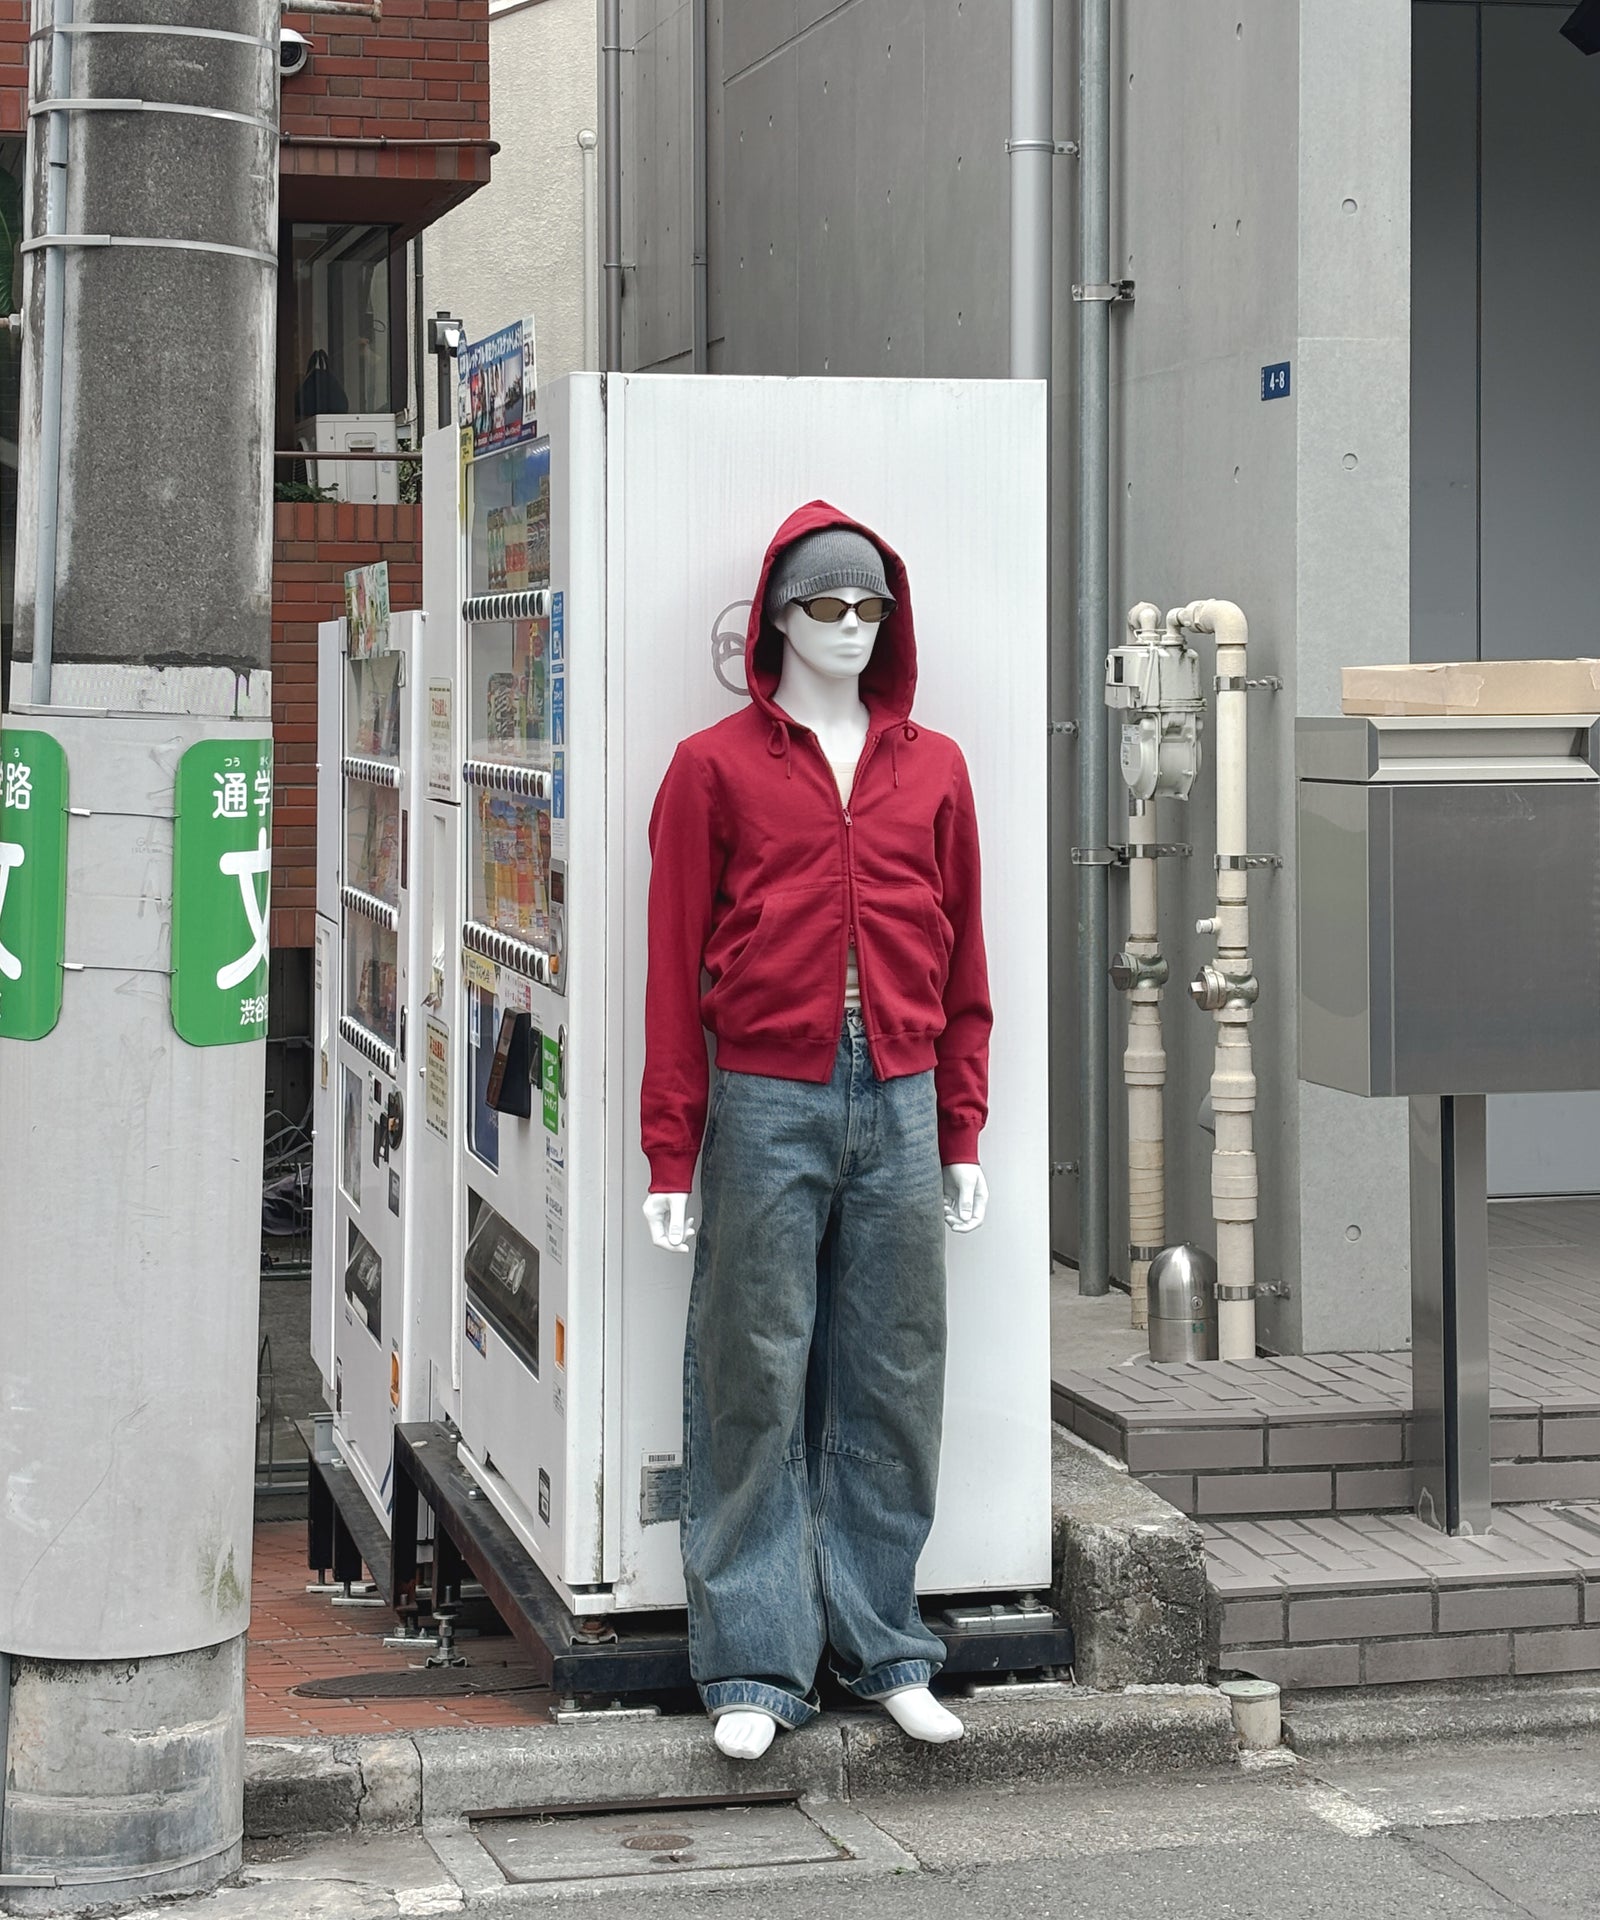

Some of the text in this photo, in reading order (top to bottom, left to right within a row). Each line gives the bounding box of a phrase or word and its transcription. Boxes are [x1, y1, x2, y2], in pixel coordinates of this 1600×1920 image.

[1269, 371, 1286, 391] 4-8
[13, 747, 20, 758] ろ
[224, 757, 241, 767] つう
[0, 761, 33, 810] 路
